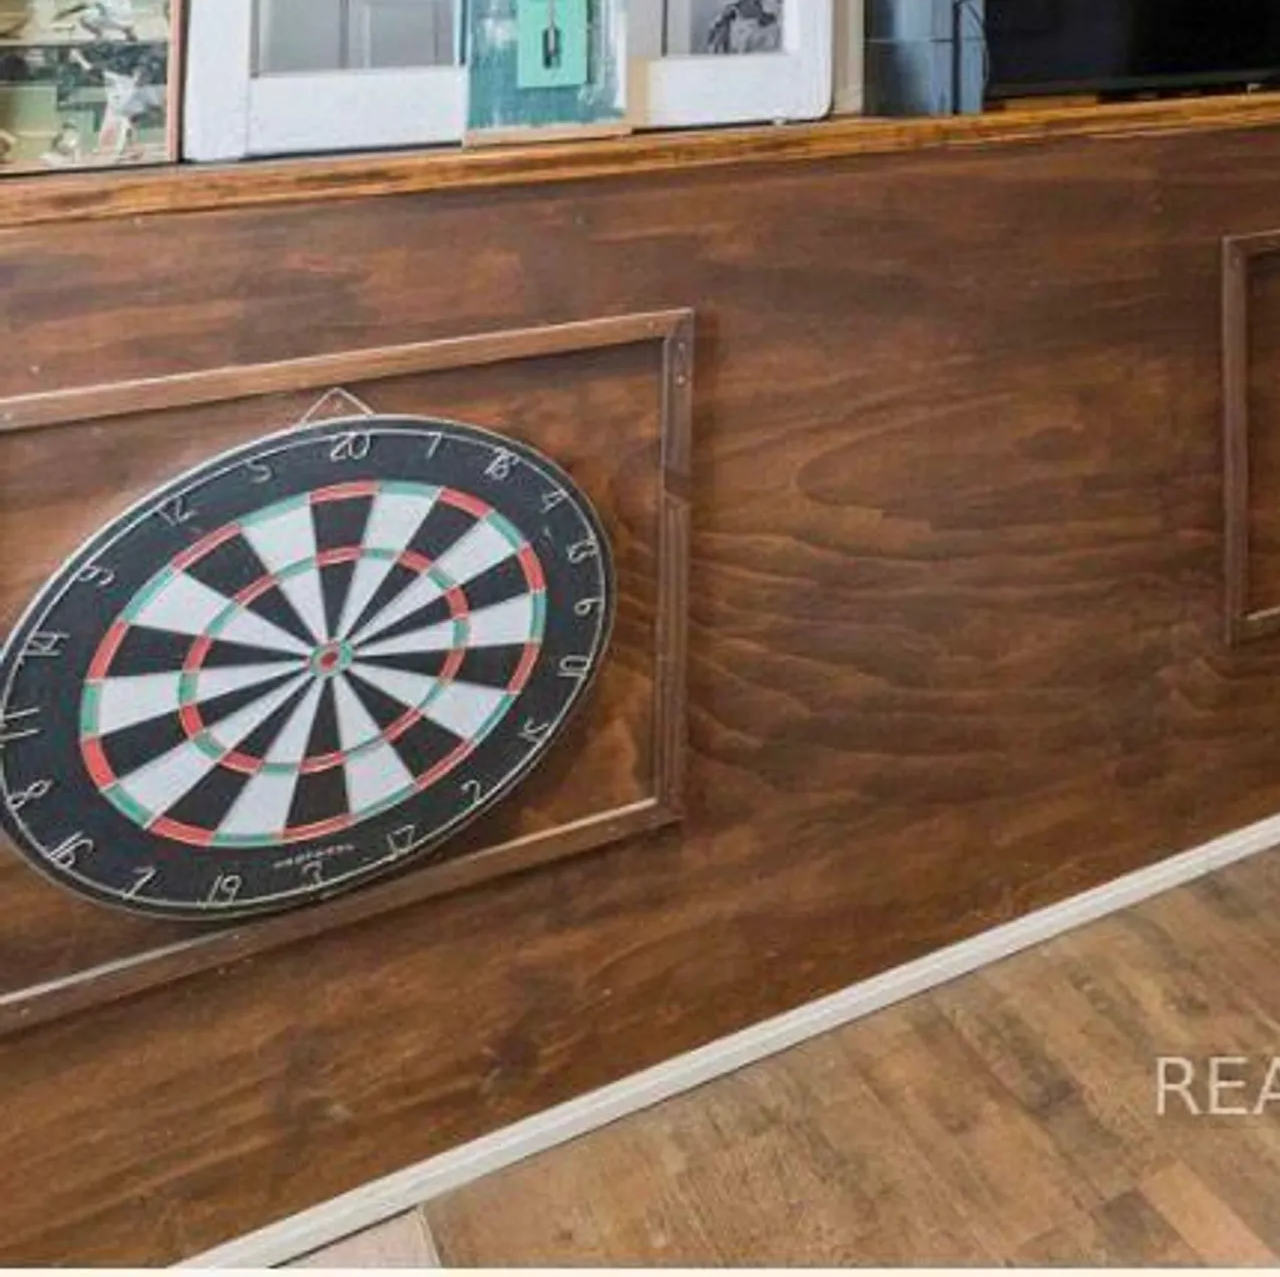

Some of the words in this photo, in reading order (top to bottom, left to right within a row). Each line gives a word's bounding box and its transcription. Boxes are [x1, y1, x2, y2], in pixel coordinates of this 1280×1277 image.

[330, 431, 372, 462] 20
[556, 654, 592, 679] 10
[206, 874, 242, 905] 19
